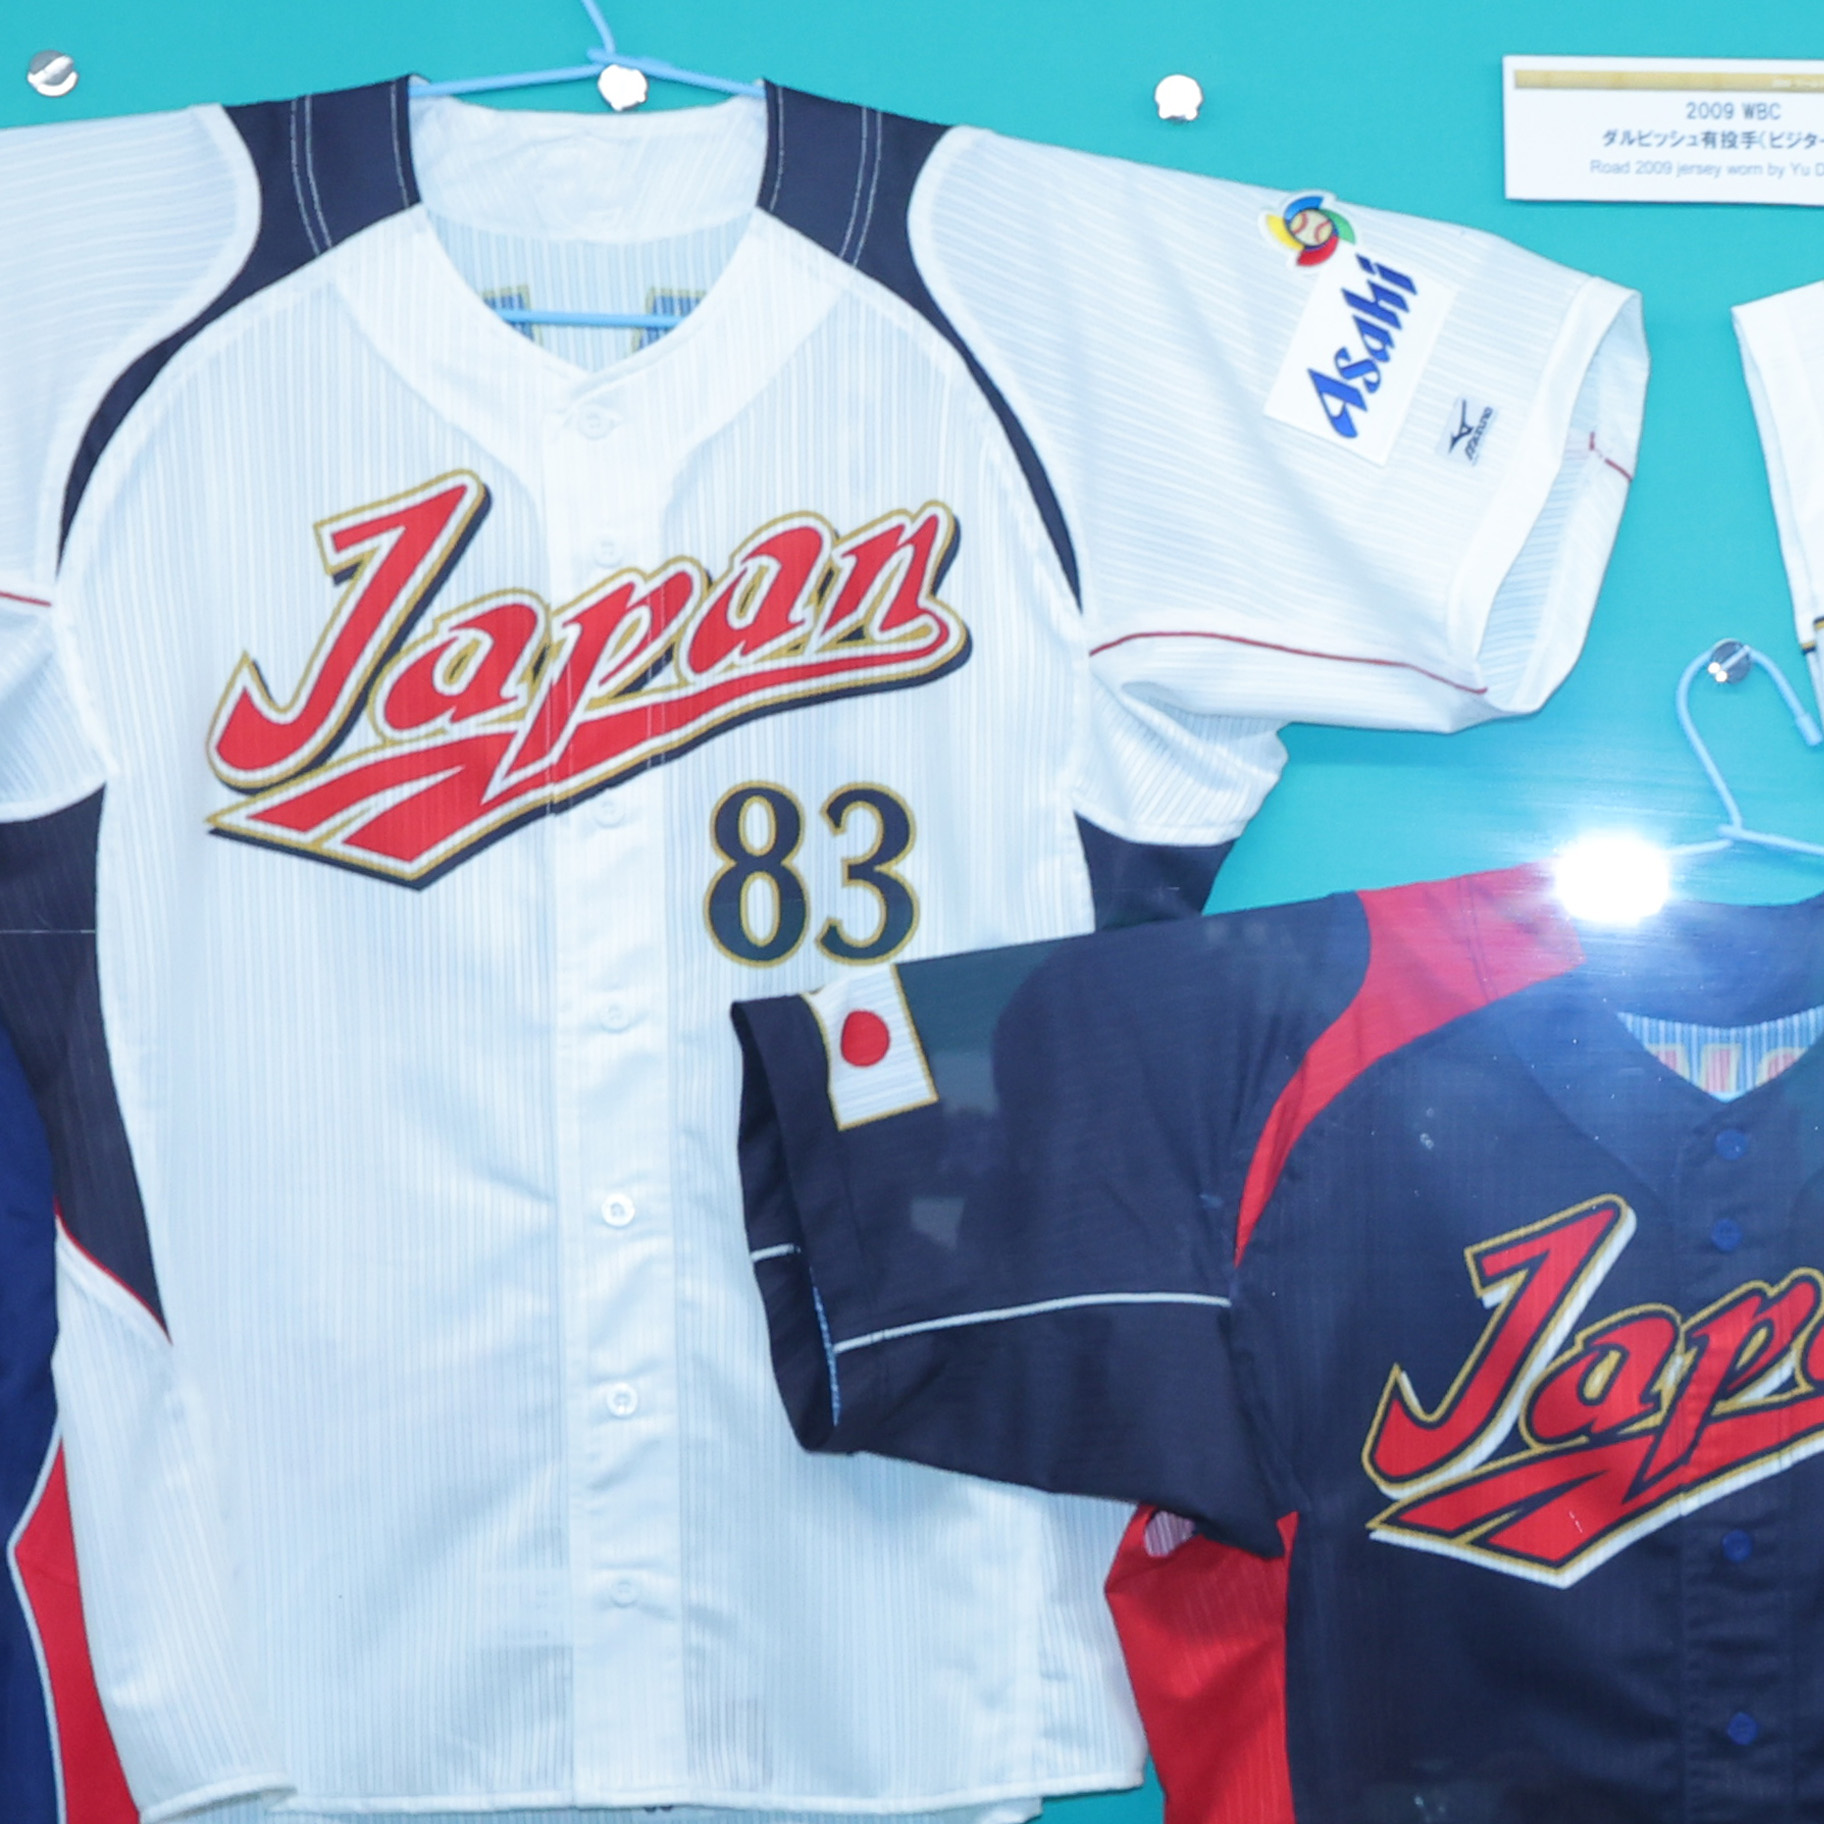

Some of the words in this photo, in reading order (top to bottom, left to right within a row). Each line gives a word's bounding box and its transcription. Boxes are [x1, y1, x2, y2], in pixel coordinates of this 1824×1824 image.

[1590, 160, 1631, 176] Road
[1635, 161, 1673, 177] 2009
[1676, 162, 1722, 179] jersey
[1767, 163, 1785, 179] by
[1790, 163, 1811, 178] Yu
[1686, 102, 1735, 121] 2009
[1742, 103, 1782, 121] WBC
[1307, 253, 1418, 439] Asahi
[206, 469, 972, 891] Japan
[703, 780, 921, 967] 83
